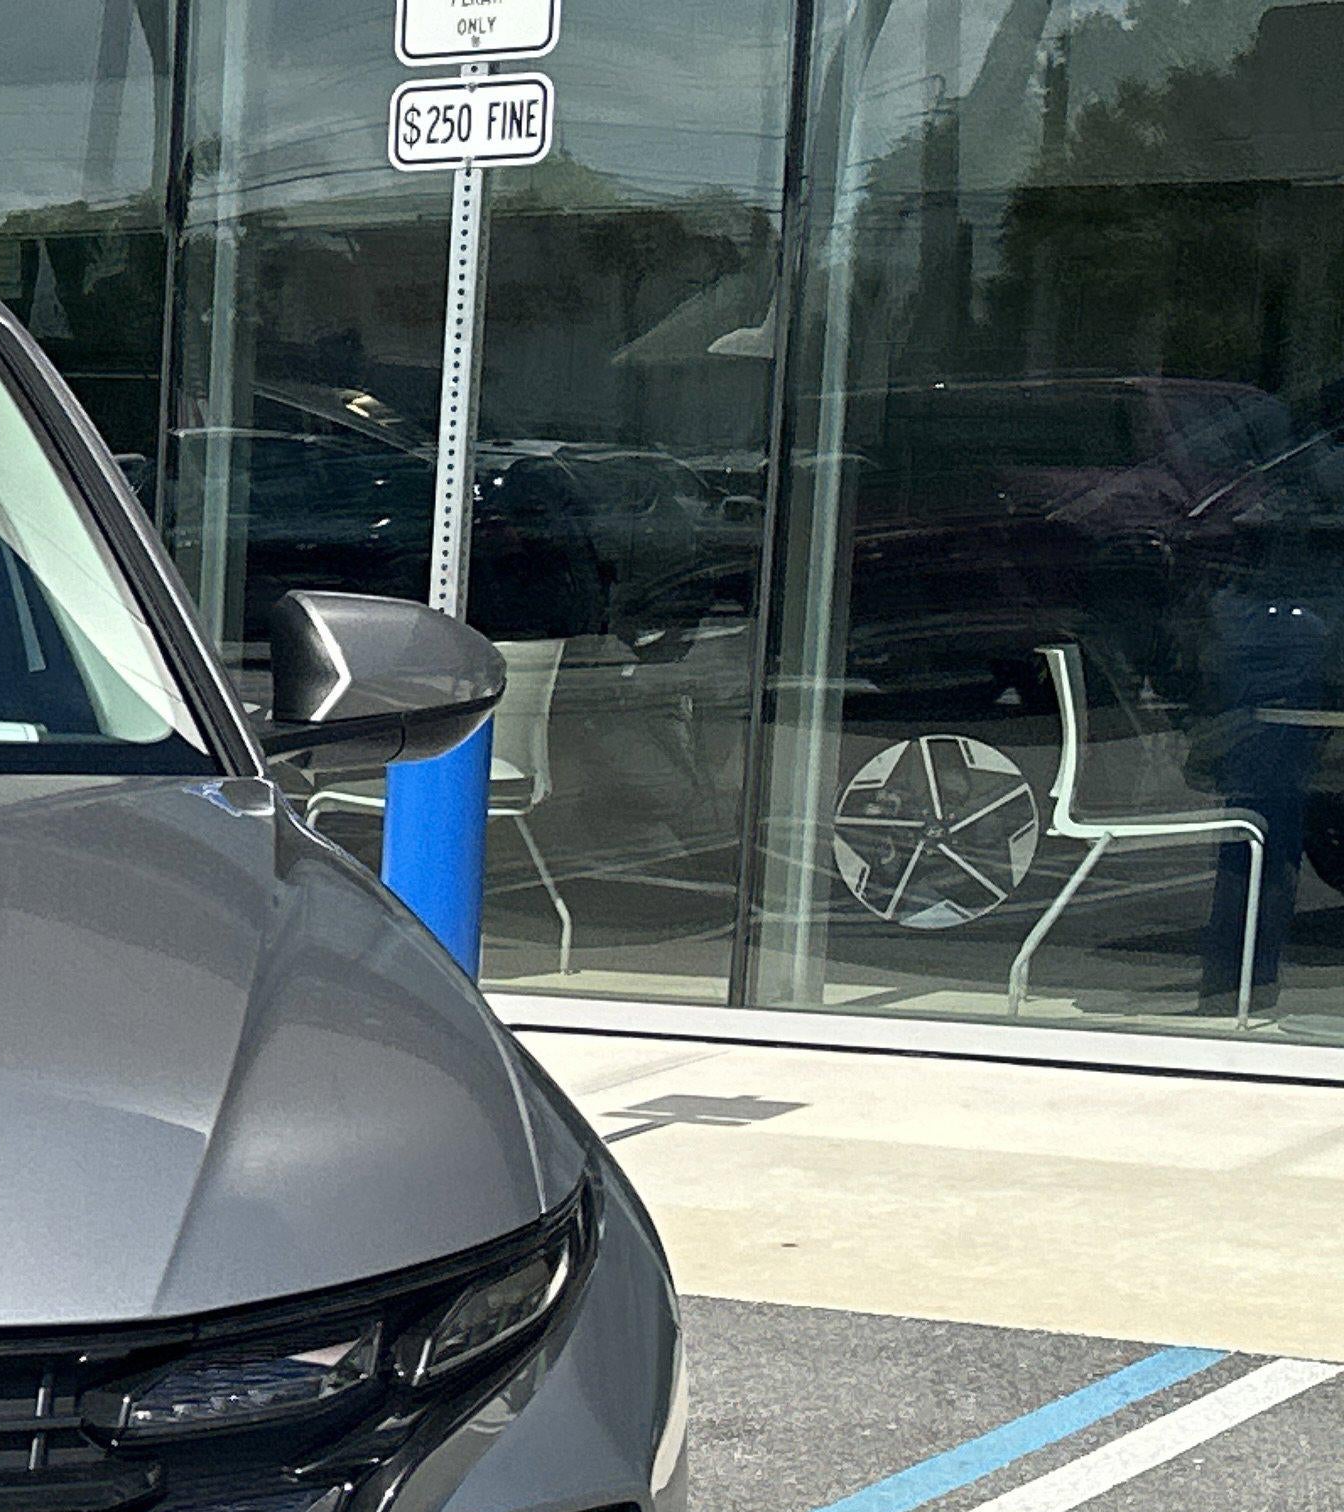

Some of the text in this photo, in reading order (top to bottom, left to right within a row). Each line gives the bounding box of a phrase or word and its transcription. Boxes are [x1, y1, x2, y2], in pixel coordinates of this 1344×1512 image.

[457, 16, 497, 36] ONLY
[403, 99, 540, 150] $250 FINE
